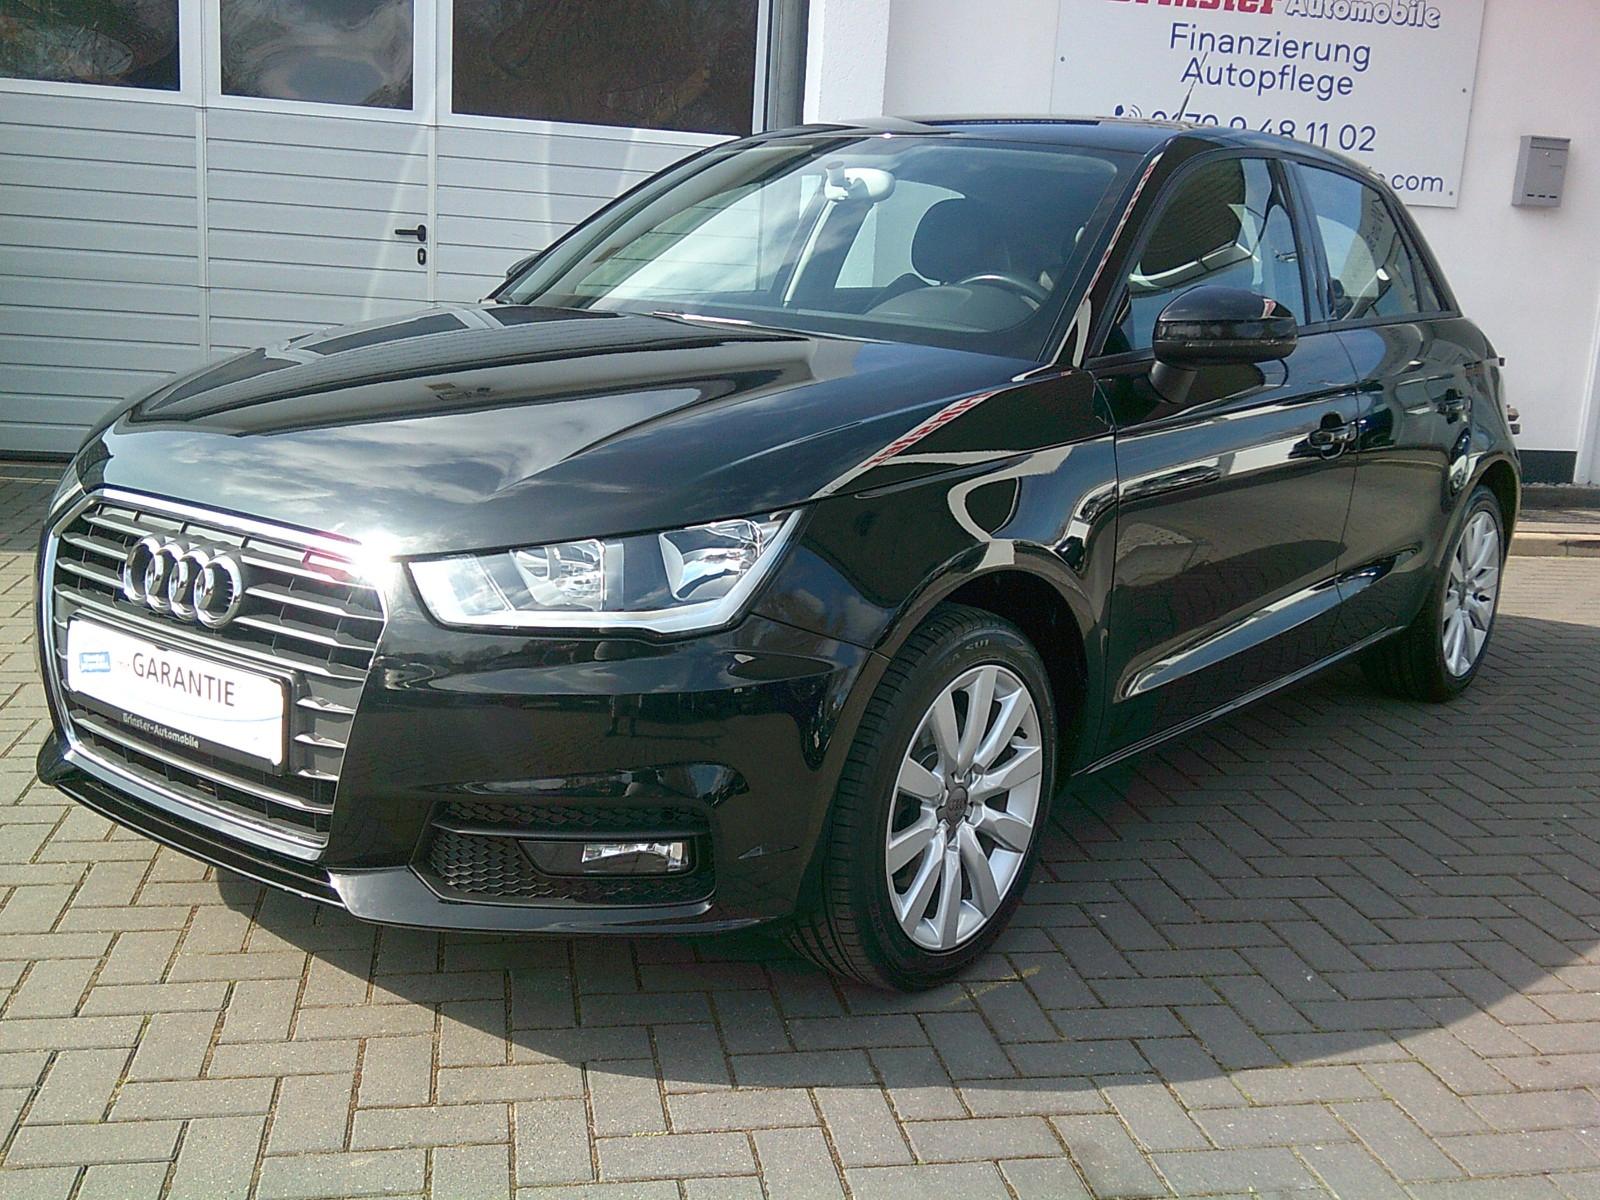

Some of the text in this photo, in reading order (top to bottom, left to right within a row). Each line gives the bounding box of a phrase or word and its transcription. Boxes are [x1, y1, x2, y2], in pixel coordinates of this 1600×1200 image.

[1285, 0, 1441, 29] Automobile
[1170, 22, 1371, 72] Finanzierung
[1180, 57, 1353, 101] Autopflege
[1305, 121, 1330, 148] 11
[1338, 123, 1377, 152] 02
[132, 651, 235, 707] GARANTIE
